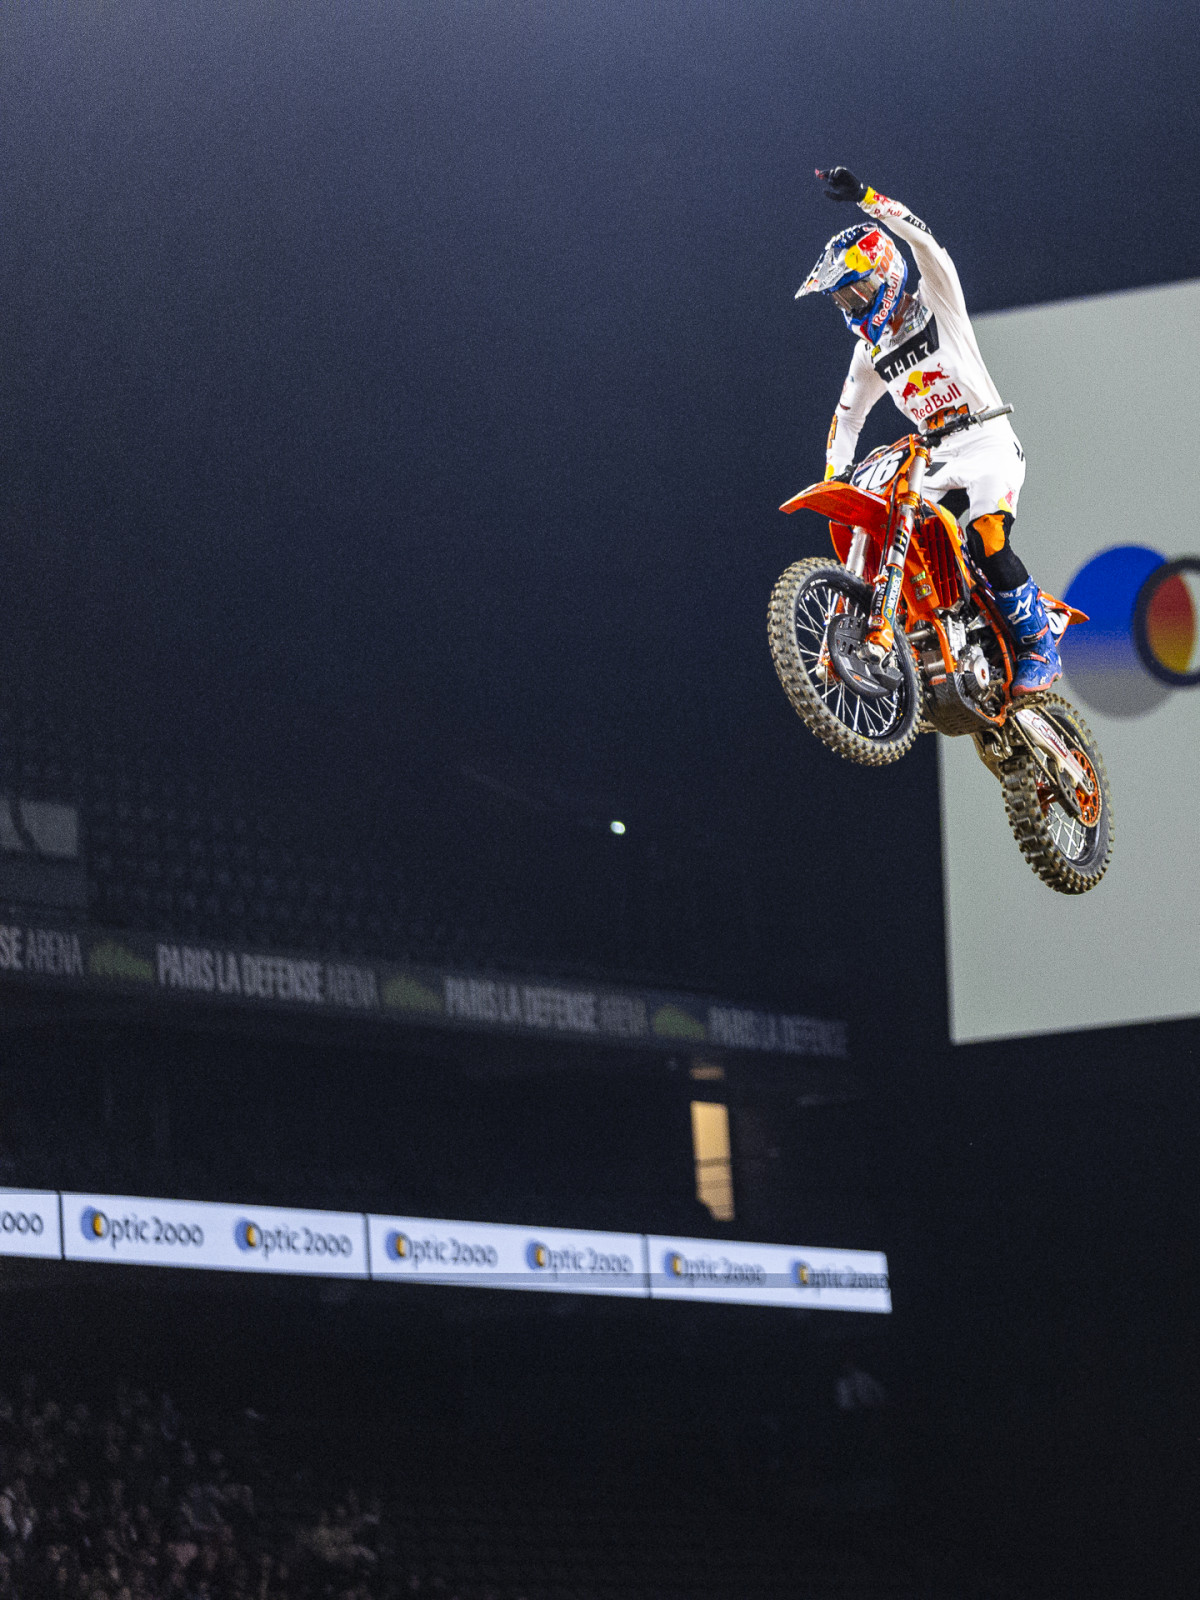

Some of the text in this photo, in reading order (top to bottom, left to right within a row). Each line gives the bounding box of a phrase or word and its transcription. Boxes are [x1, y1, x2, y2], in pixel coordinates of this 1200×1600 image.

[872, 271, 901, 327] Red Bull
[884, 341, 932, 381] THOR
[911, 382, 963, 422] Red Bull
[156, 943, 214, 992] PARIS
[214, 949, 242, 995] LA
[241, 953, 324, 1004] DEFENSE
[93, 1210, 205, 1248] Optic 2000
[246, 1221, 353, 1260] Optic 2000
[396, 1232, 499, 1269] Optic 2000
